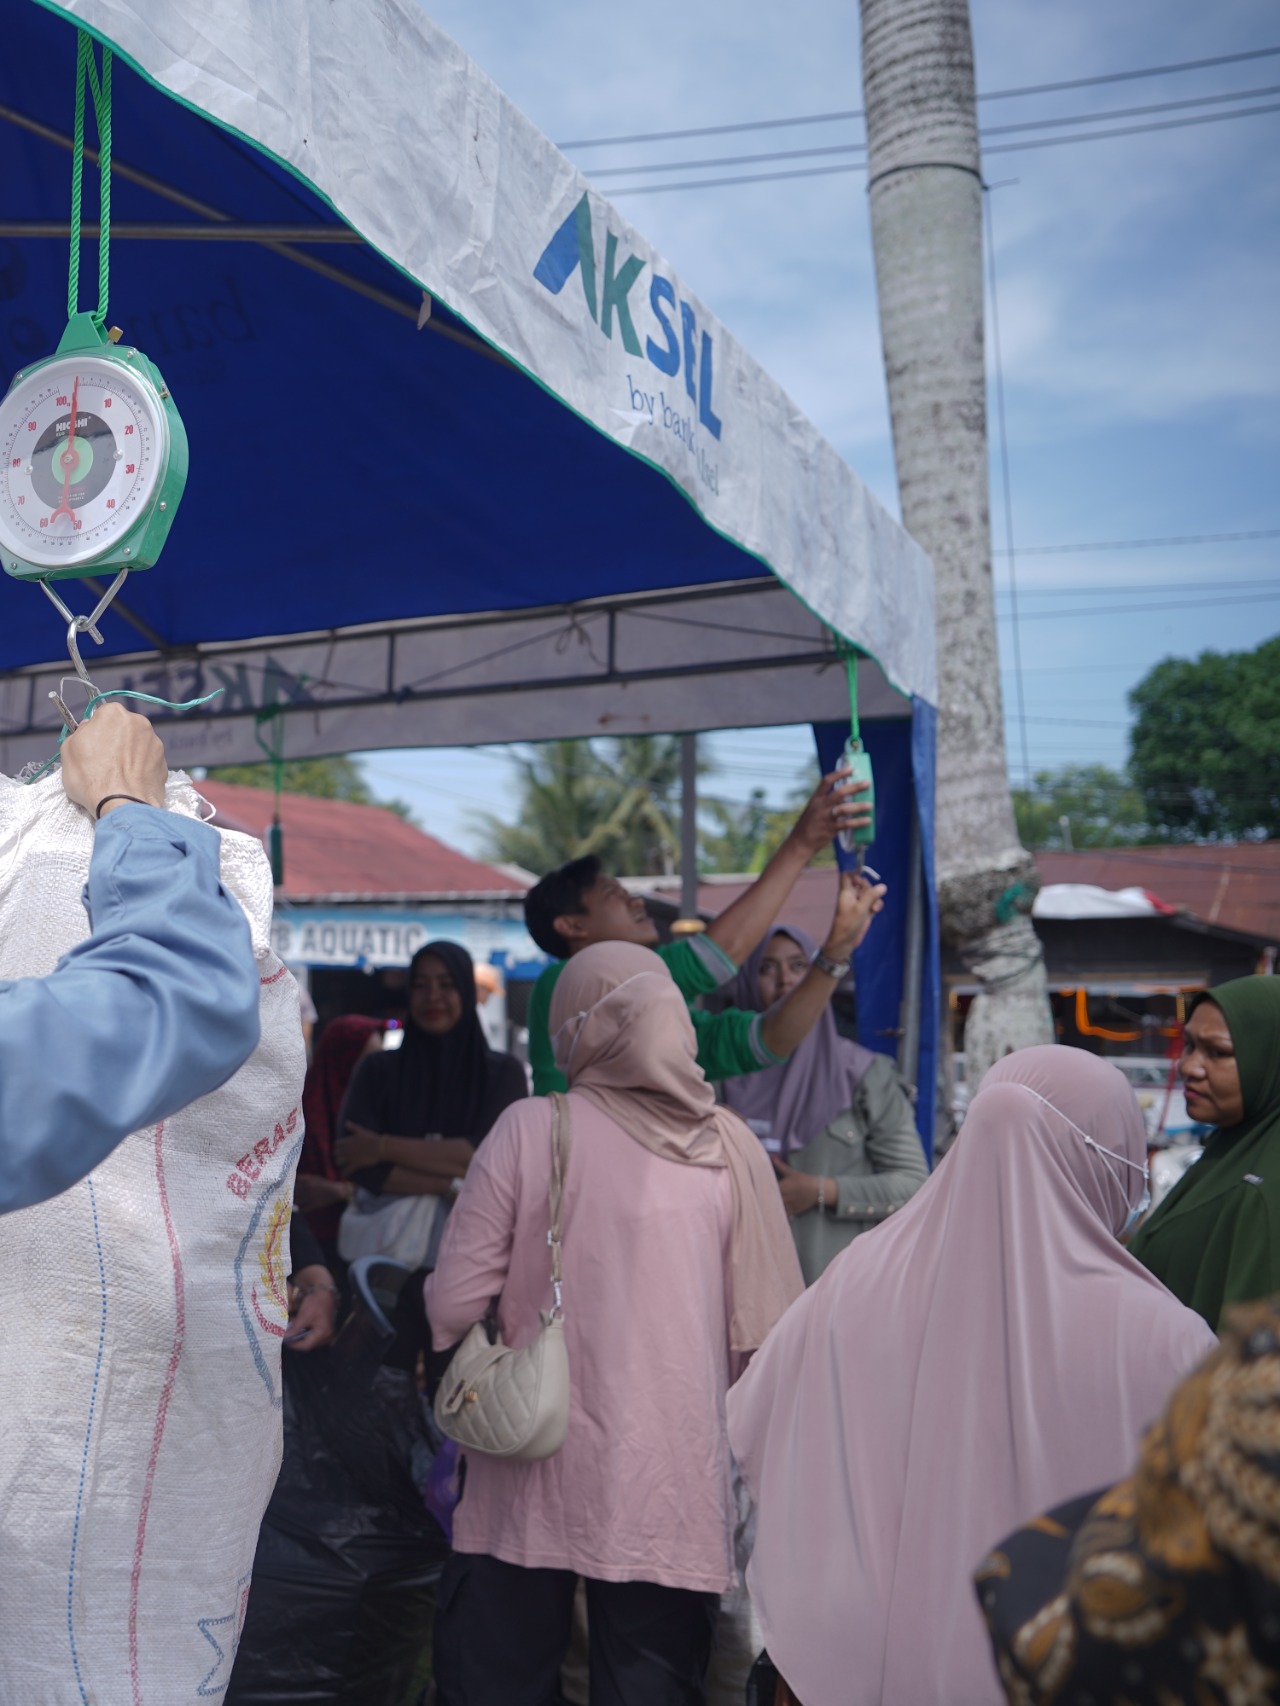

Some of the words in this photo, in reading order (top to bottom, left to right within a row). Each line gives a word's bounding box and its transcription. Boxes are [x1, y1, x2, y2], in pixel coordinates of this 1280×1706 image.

[533, 190, 722, 442] AKSEL
[55, 395, 67, 407] 100
[104, 398, 112, 408] 10
[626, 374, 655, 426] by
[27, 421, 37, 431] 90
[124, 424, 134, 435] 20
[125, 463, 135, 474] 30
[17, 495, 25, 505] 70
[106, 498, 116, 509] 40
[39, 517, 48, 528] 60
[73, 519, 82, 530] 50
[302, 923, 422, 956] AQUATIC
[225, 1106, 298, 1200] BERAS
